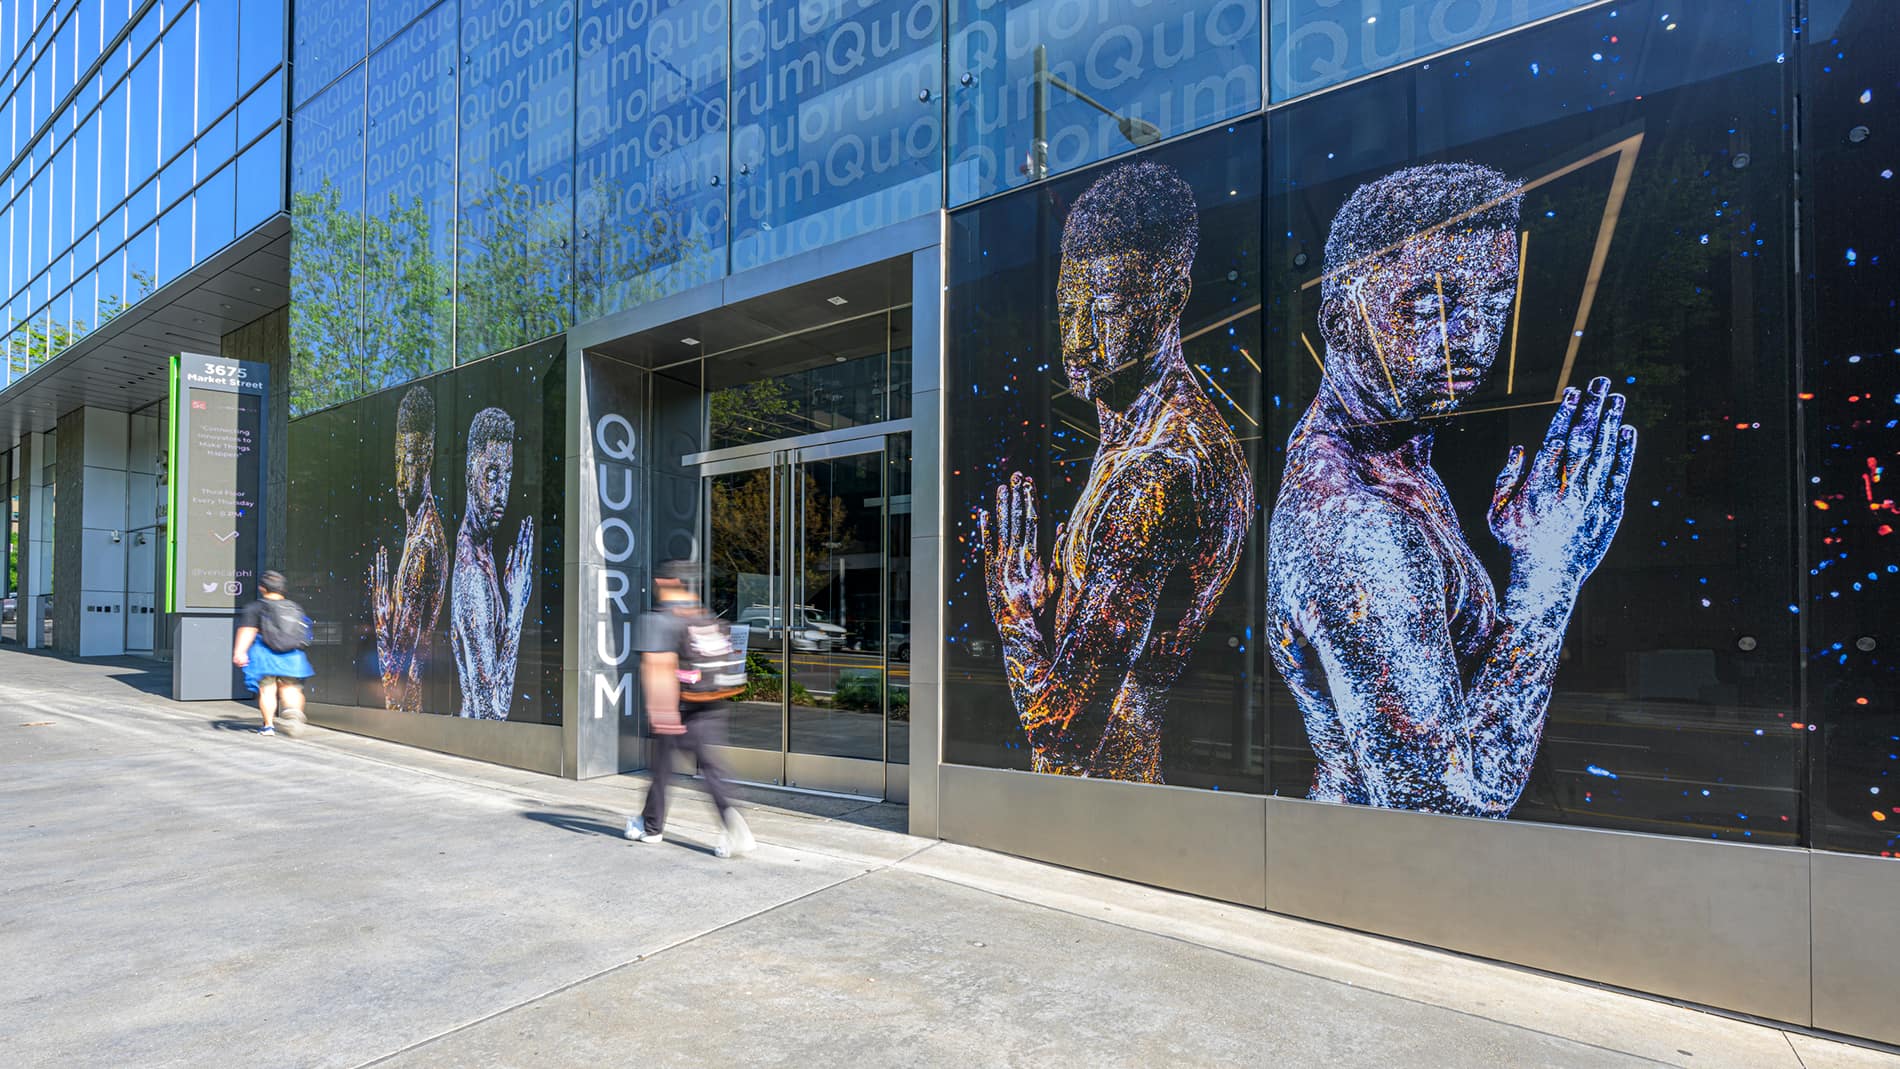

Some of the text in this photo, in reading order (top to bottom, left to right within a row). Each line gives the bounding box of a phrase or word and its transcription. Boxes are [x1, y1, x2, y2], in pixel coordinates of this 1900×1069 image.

[736, 50, 941, 168] Quorum
[187, 373, 263, 389] Market Street
[204, 363, 248, 378] 3675
[594, 413, 636, 718] QUORUM
